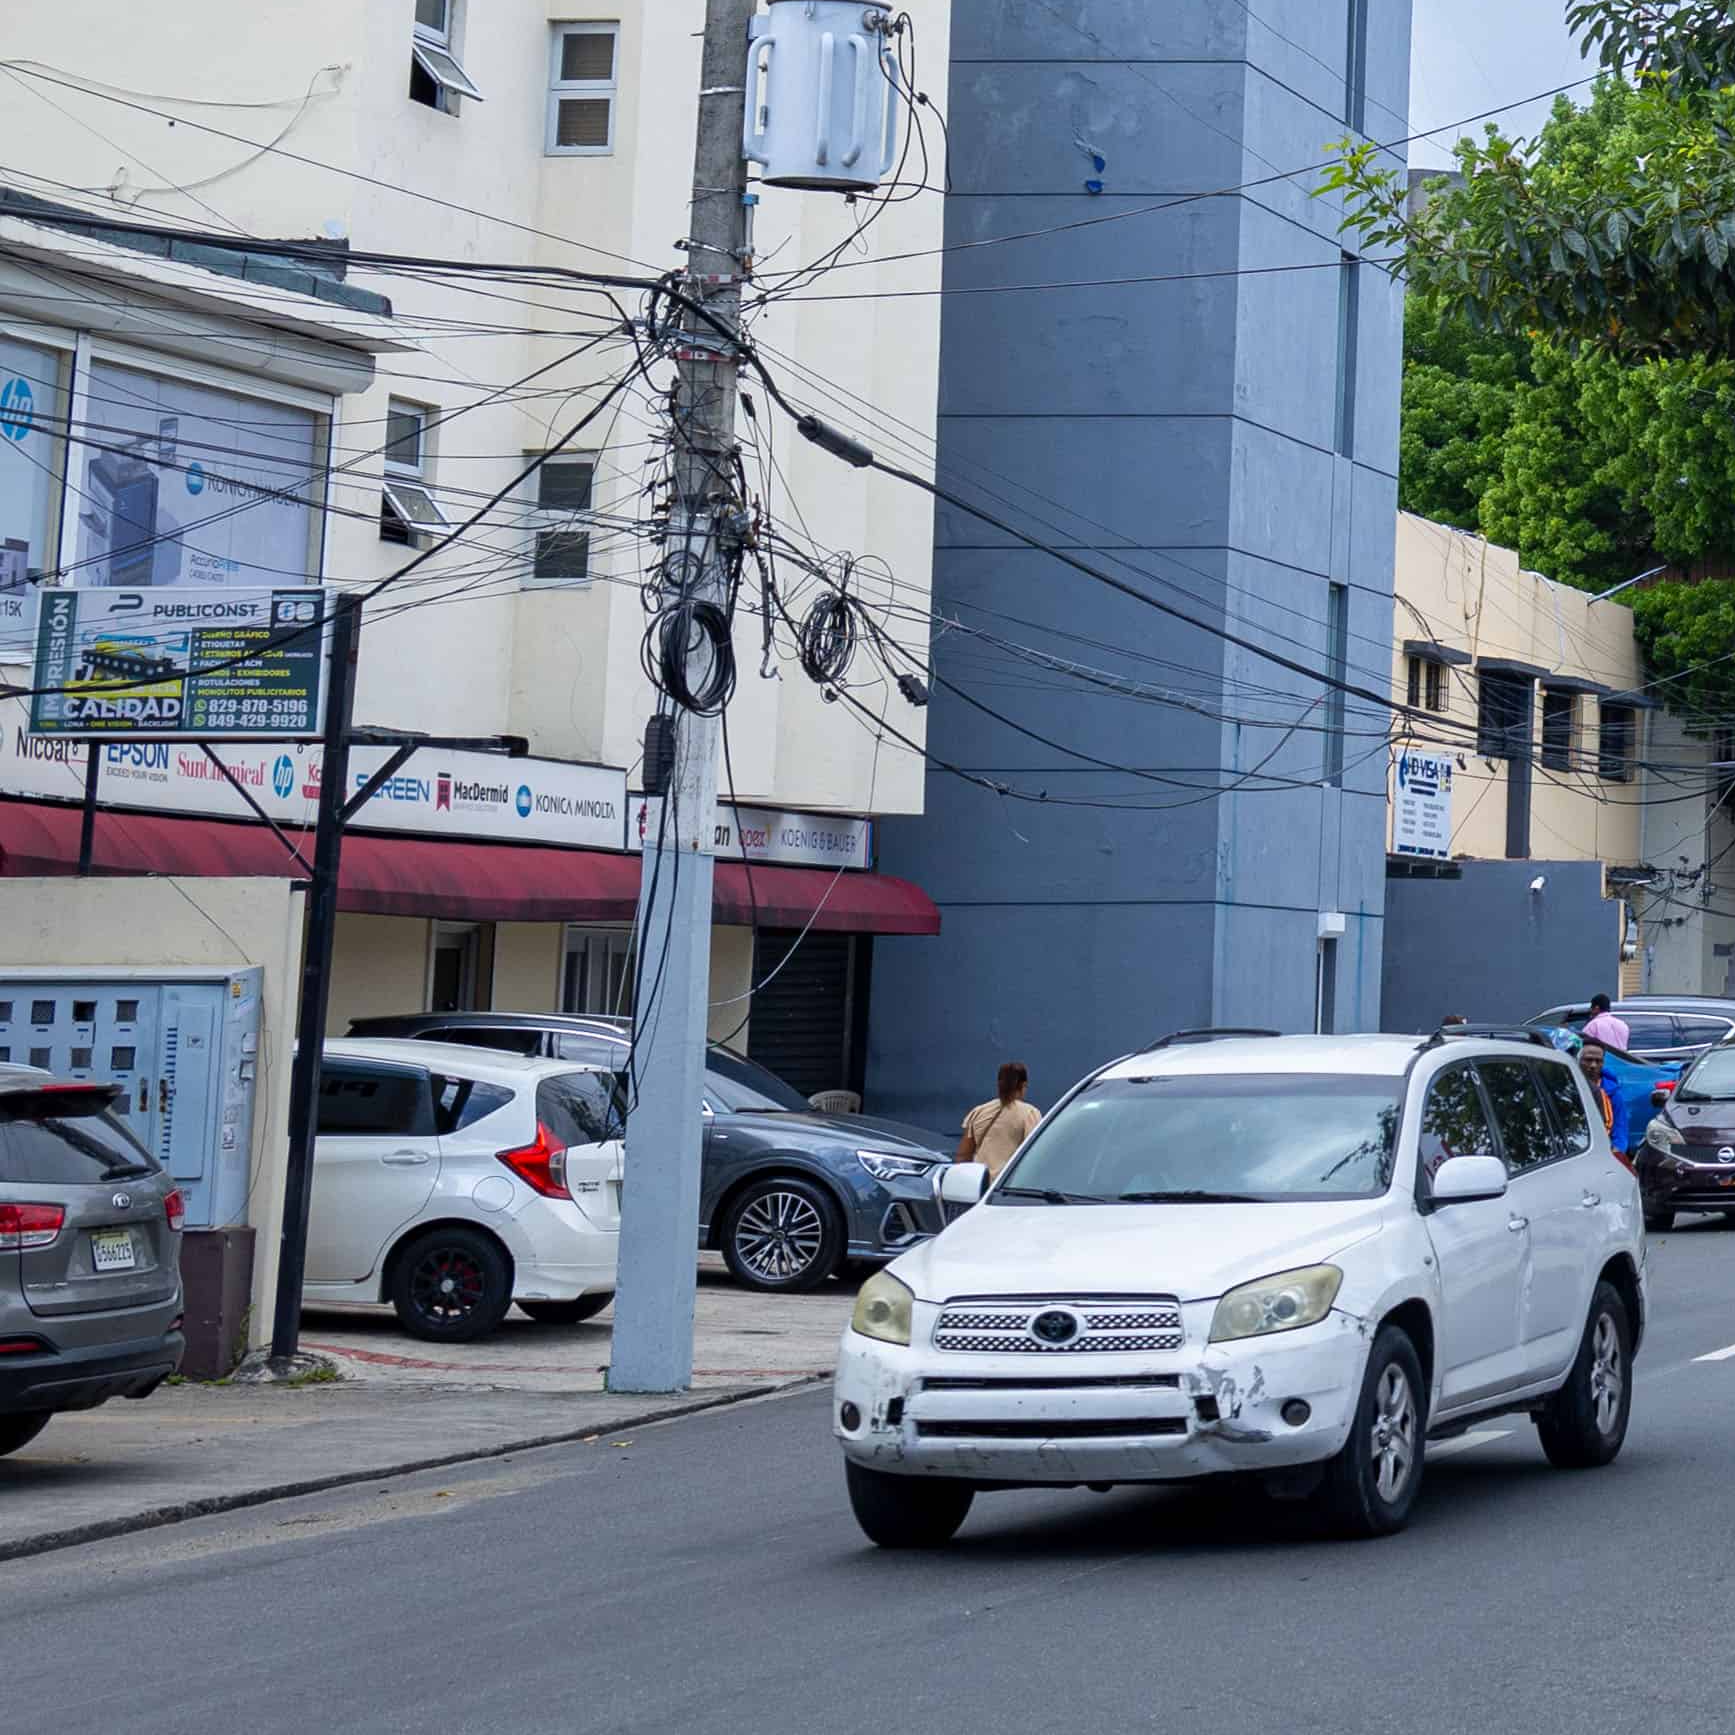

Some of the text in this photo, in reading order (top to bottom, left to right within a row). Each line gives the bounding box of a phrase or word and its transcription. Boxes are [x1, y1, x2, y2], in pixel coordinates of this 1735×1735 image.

[154, 603, 259, 617] PUBLICONST
[42, 598, 70, 718] IMPRESIÓN
[63, 697, 182, 720] CALIDAD
[208, 699, 308, 713] 829-870-5196
[107, 743, 169, 769] EPSON
[453, 781, 509, 804] MacDermid
[535, 794, 616, 820] KONICA MINOLTA
